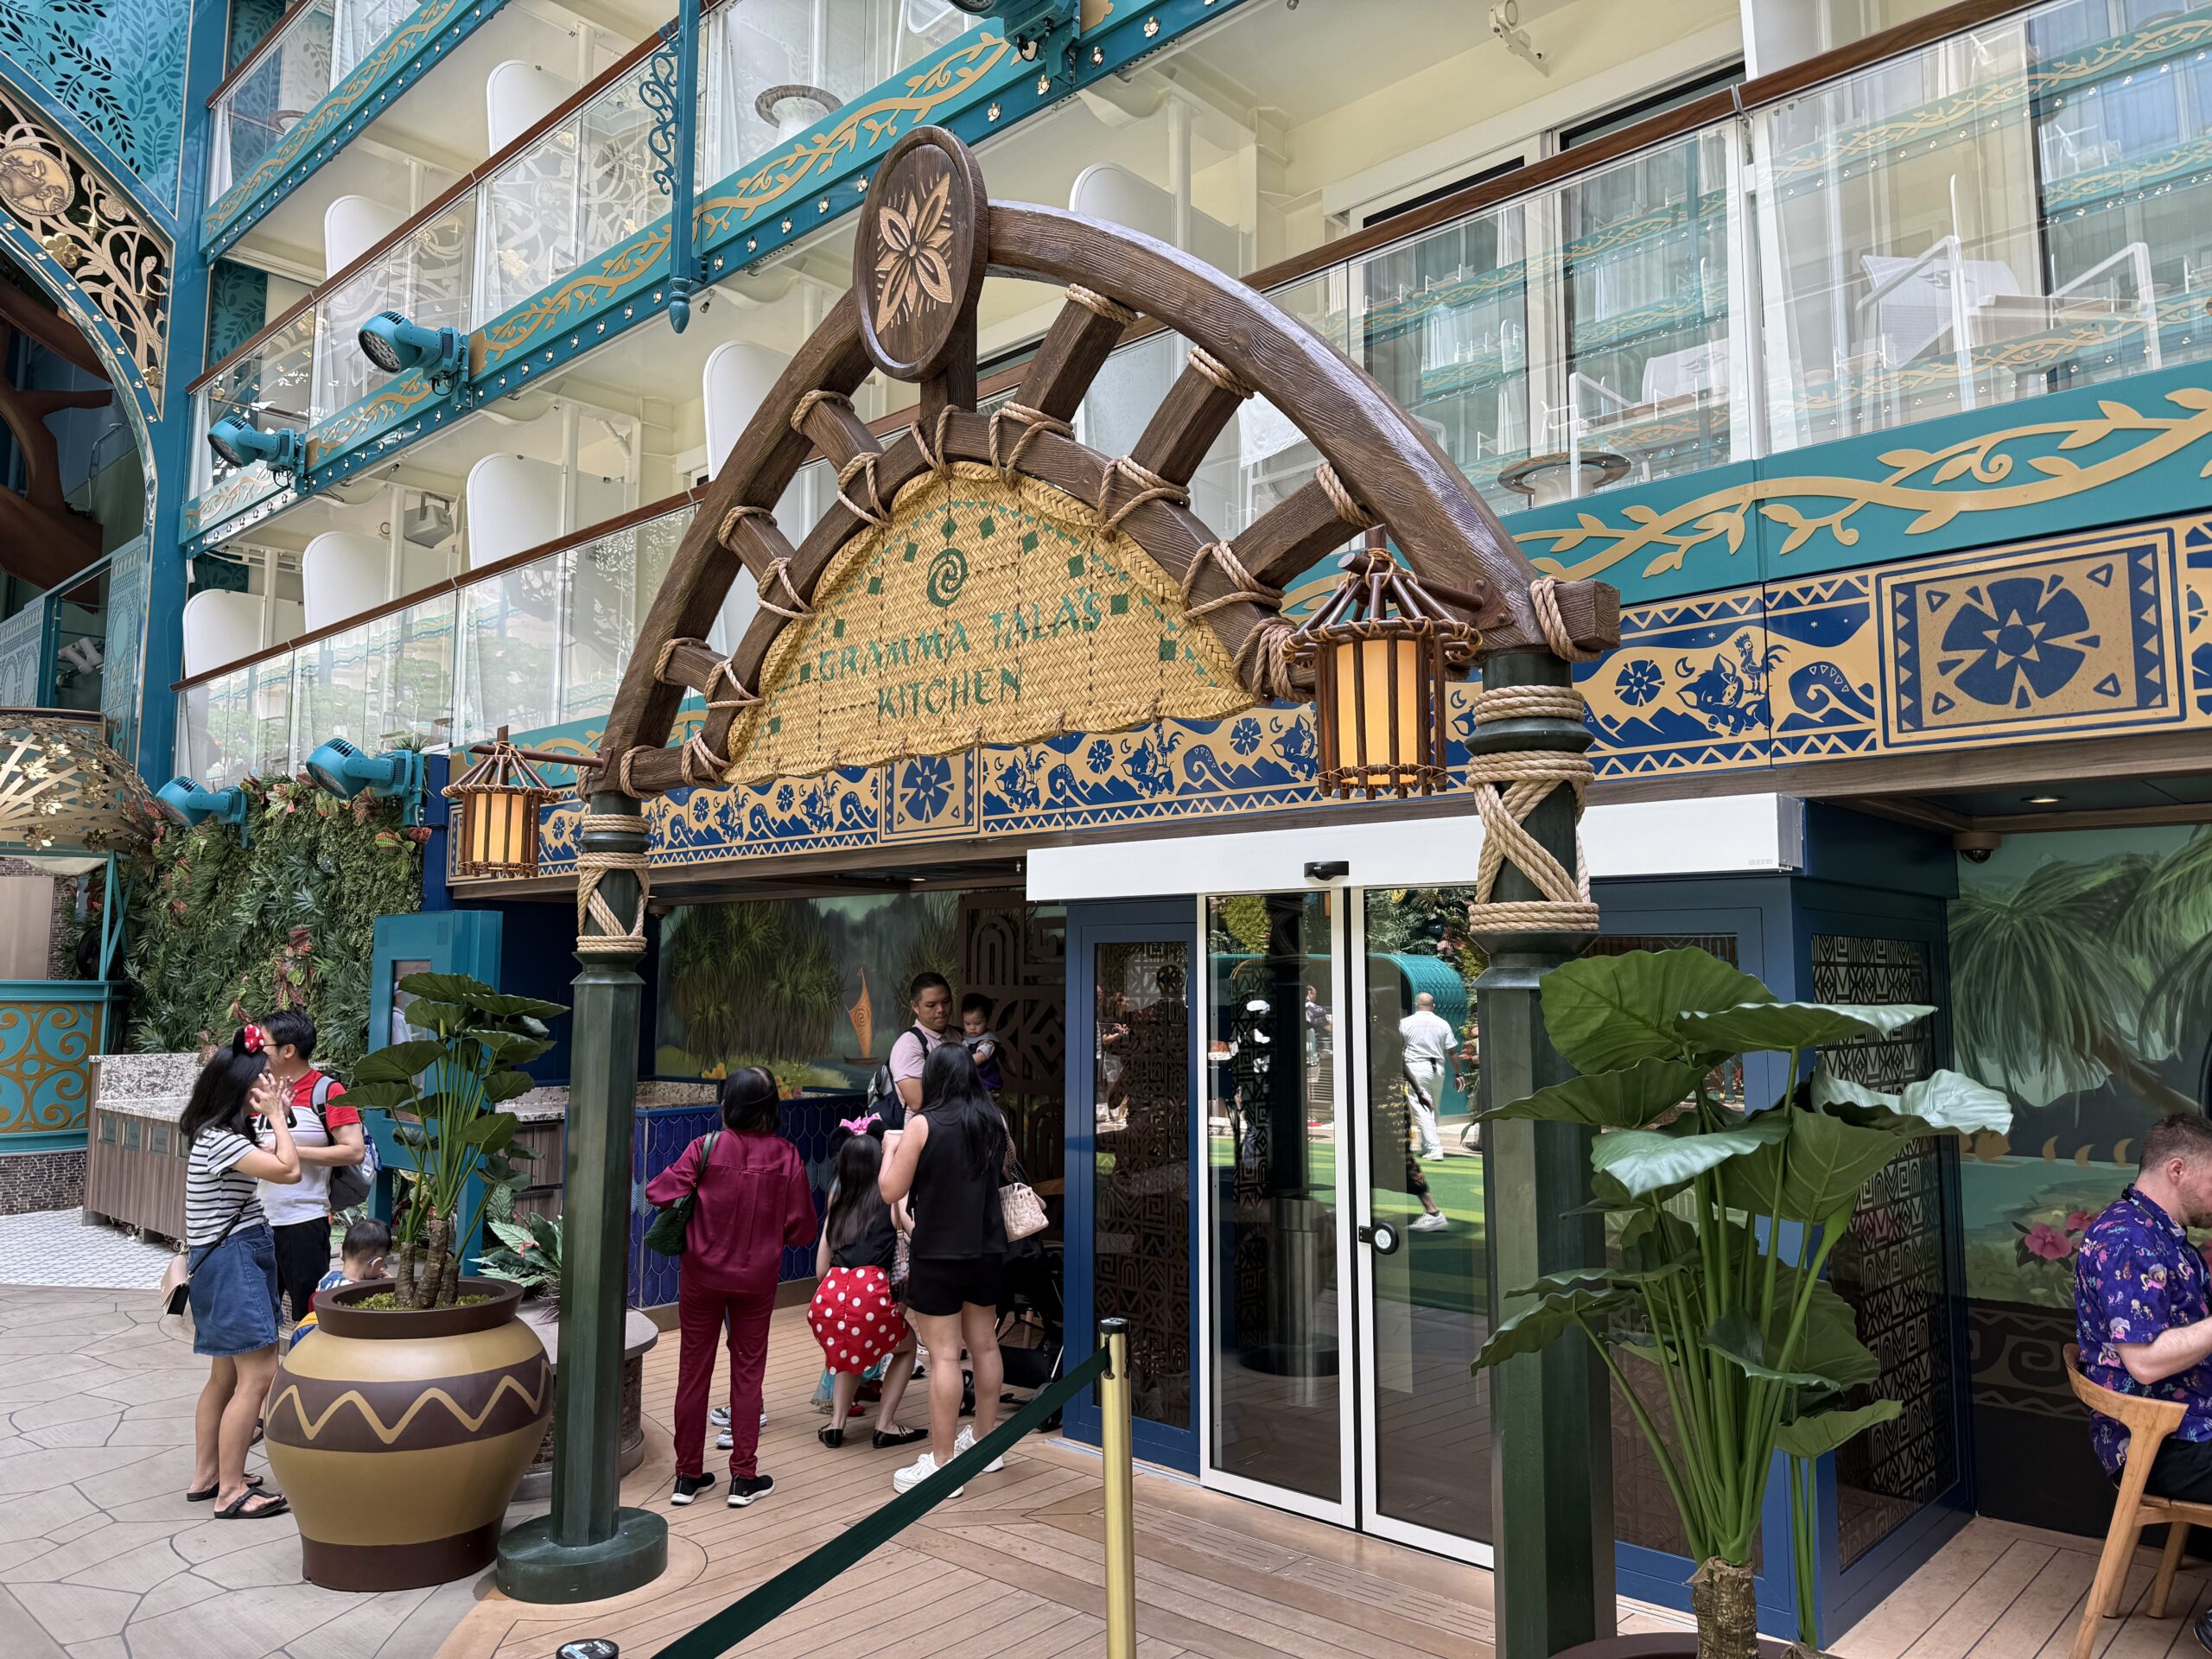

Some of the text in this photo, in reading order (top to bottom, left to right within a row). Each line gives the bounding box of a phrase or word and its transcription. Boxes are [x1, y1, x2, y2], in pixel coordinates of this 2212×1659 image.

[820, 586, 1102, 682] GRAMMA TALA'S
[877, 665, 1022, 720] KITCHEN
